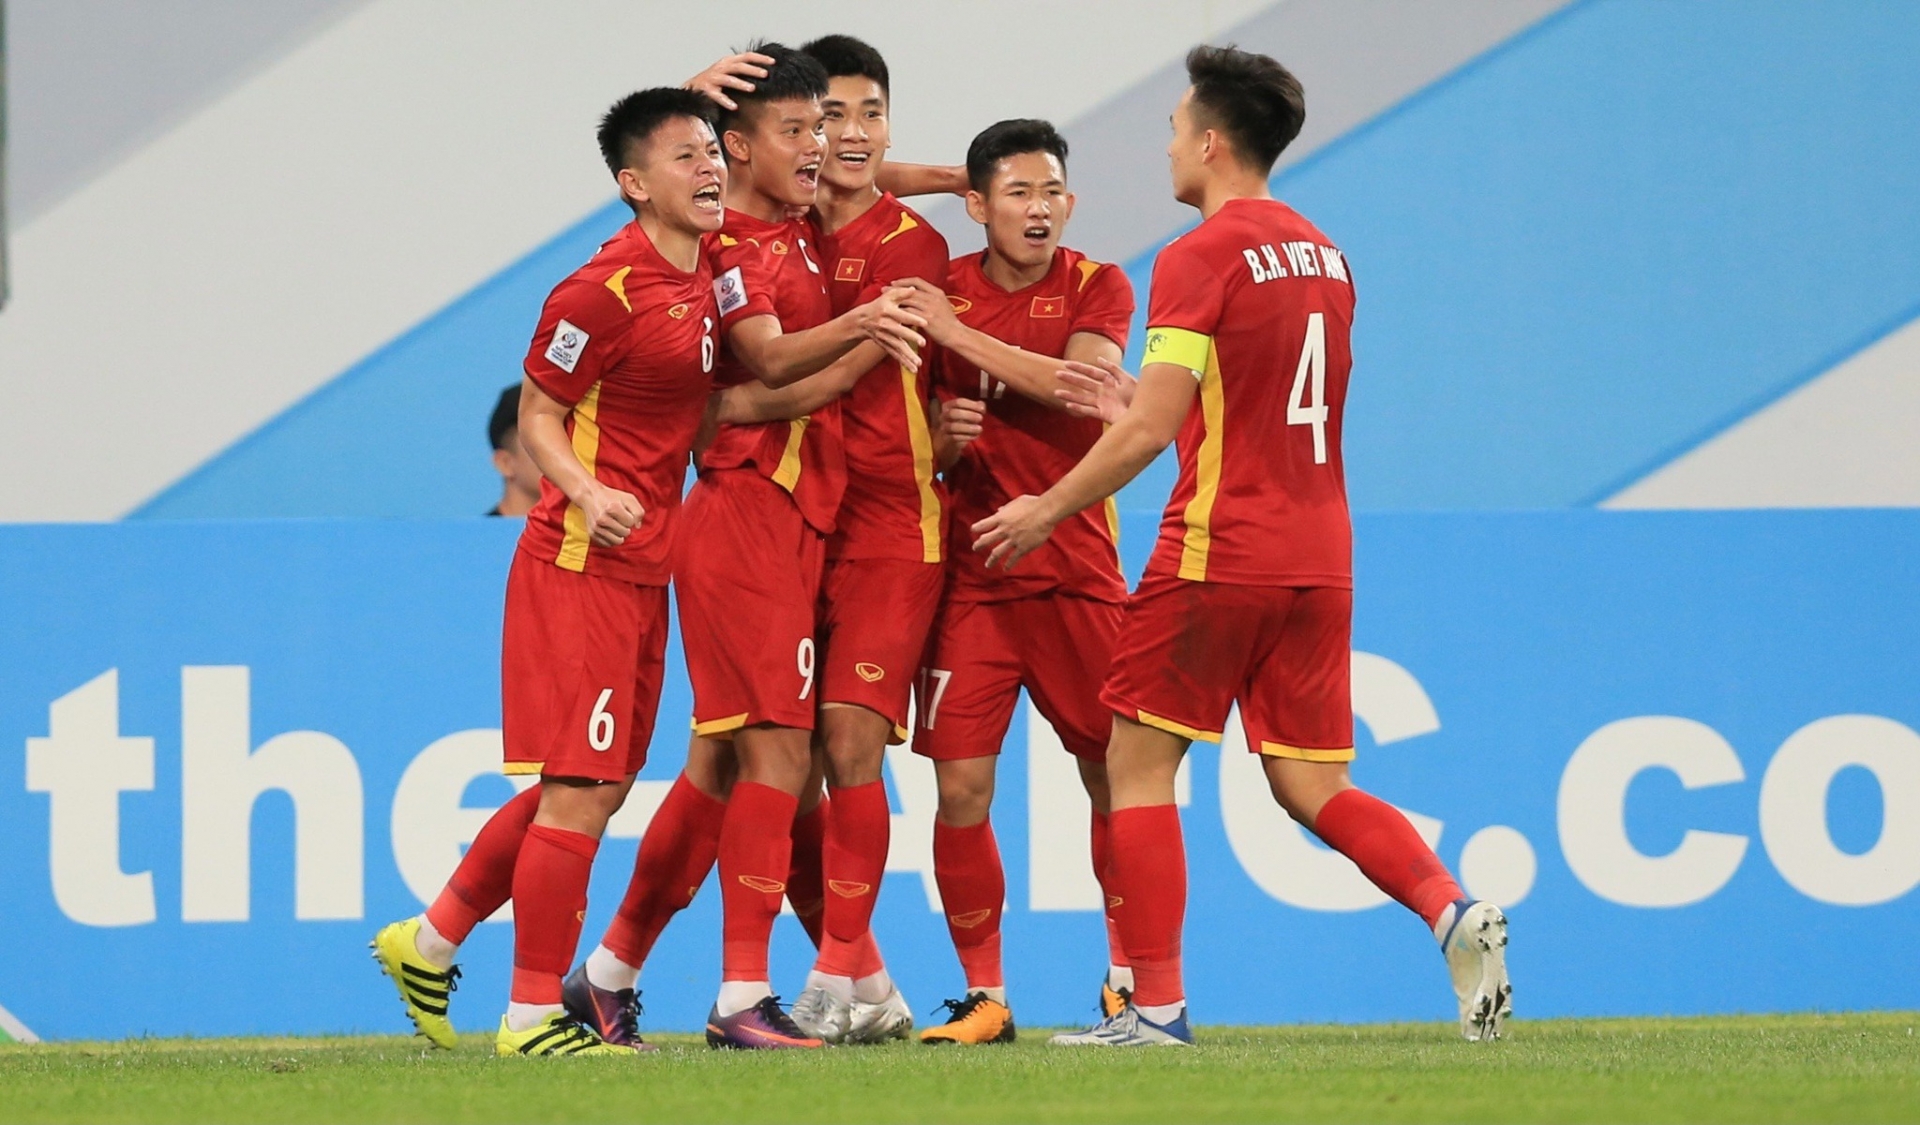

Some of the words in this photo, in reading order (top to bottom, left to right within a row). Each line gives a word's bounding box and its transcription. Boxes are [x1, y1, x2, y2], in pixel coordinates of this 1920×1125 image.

[1242, 244, 1288, 284] B.H.
[1281, 241, 1321, 277] VIET
[701, 316, 714, 374] 6
[1286, 312, 1329, 465] 4
[797, 637, 815, 700] 9
[921, 667, 953, 730] 17
[587, 688, 615, 752] 6
